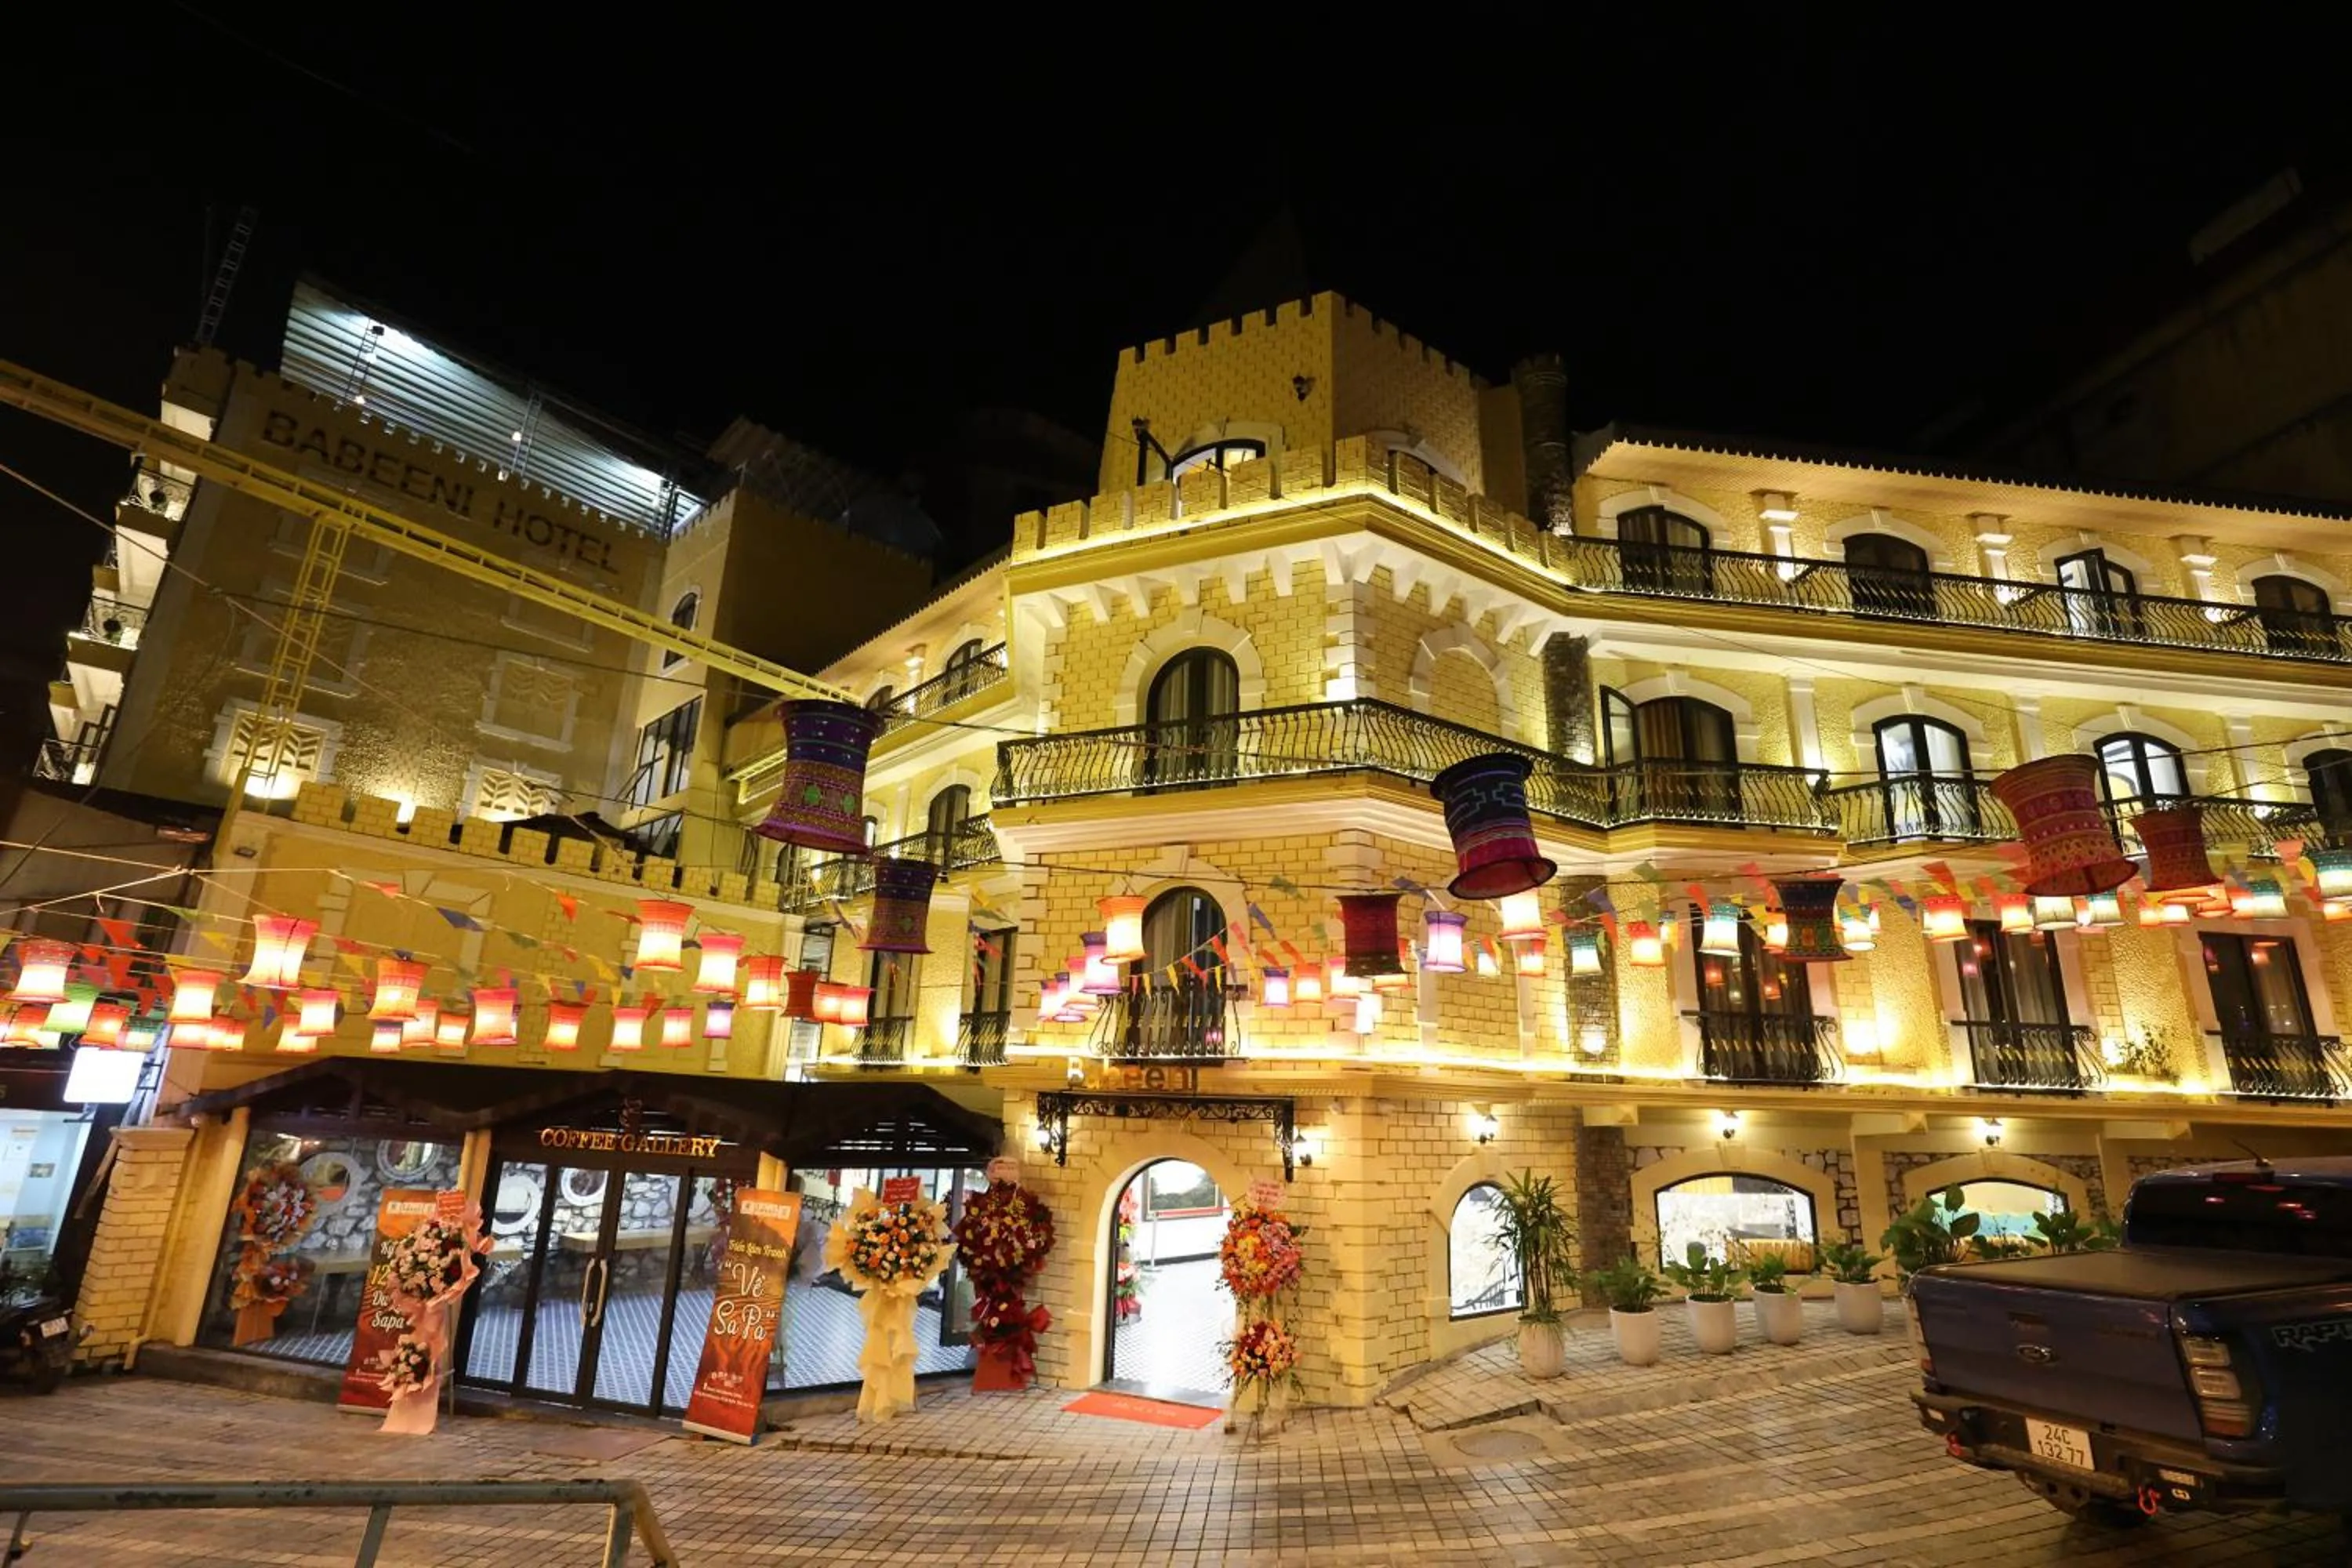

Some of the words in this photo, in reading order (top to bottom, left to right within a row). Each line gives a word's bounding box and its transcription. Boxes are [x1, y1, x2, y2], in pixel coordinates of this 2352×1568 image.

[261, 409, 477, 518] BABEENI
[493, 501, 619, 575] HOTEL
[540, 1128, 615, 1150] COFFEE
[621, 1134, 719, 1157] GALLERY
[372, 1310, 405, 1333] Sapa
[714, 1301, 737, 1334] Sa
[2045, 1425, 2071, 1444] 24C
[2038, 1440, 2085, 1465] 132.77
